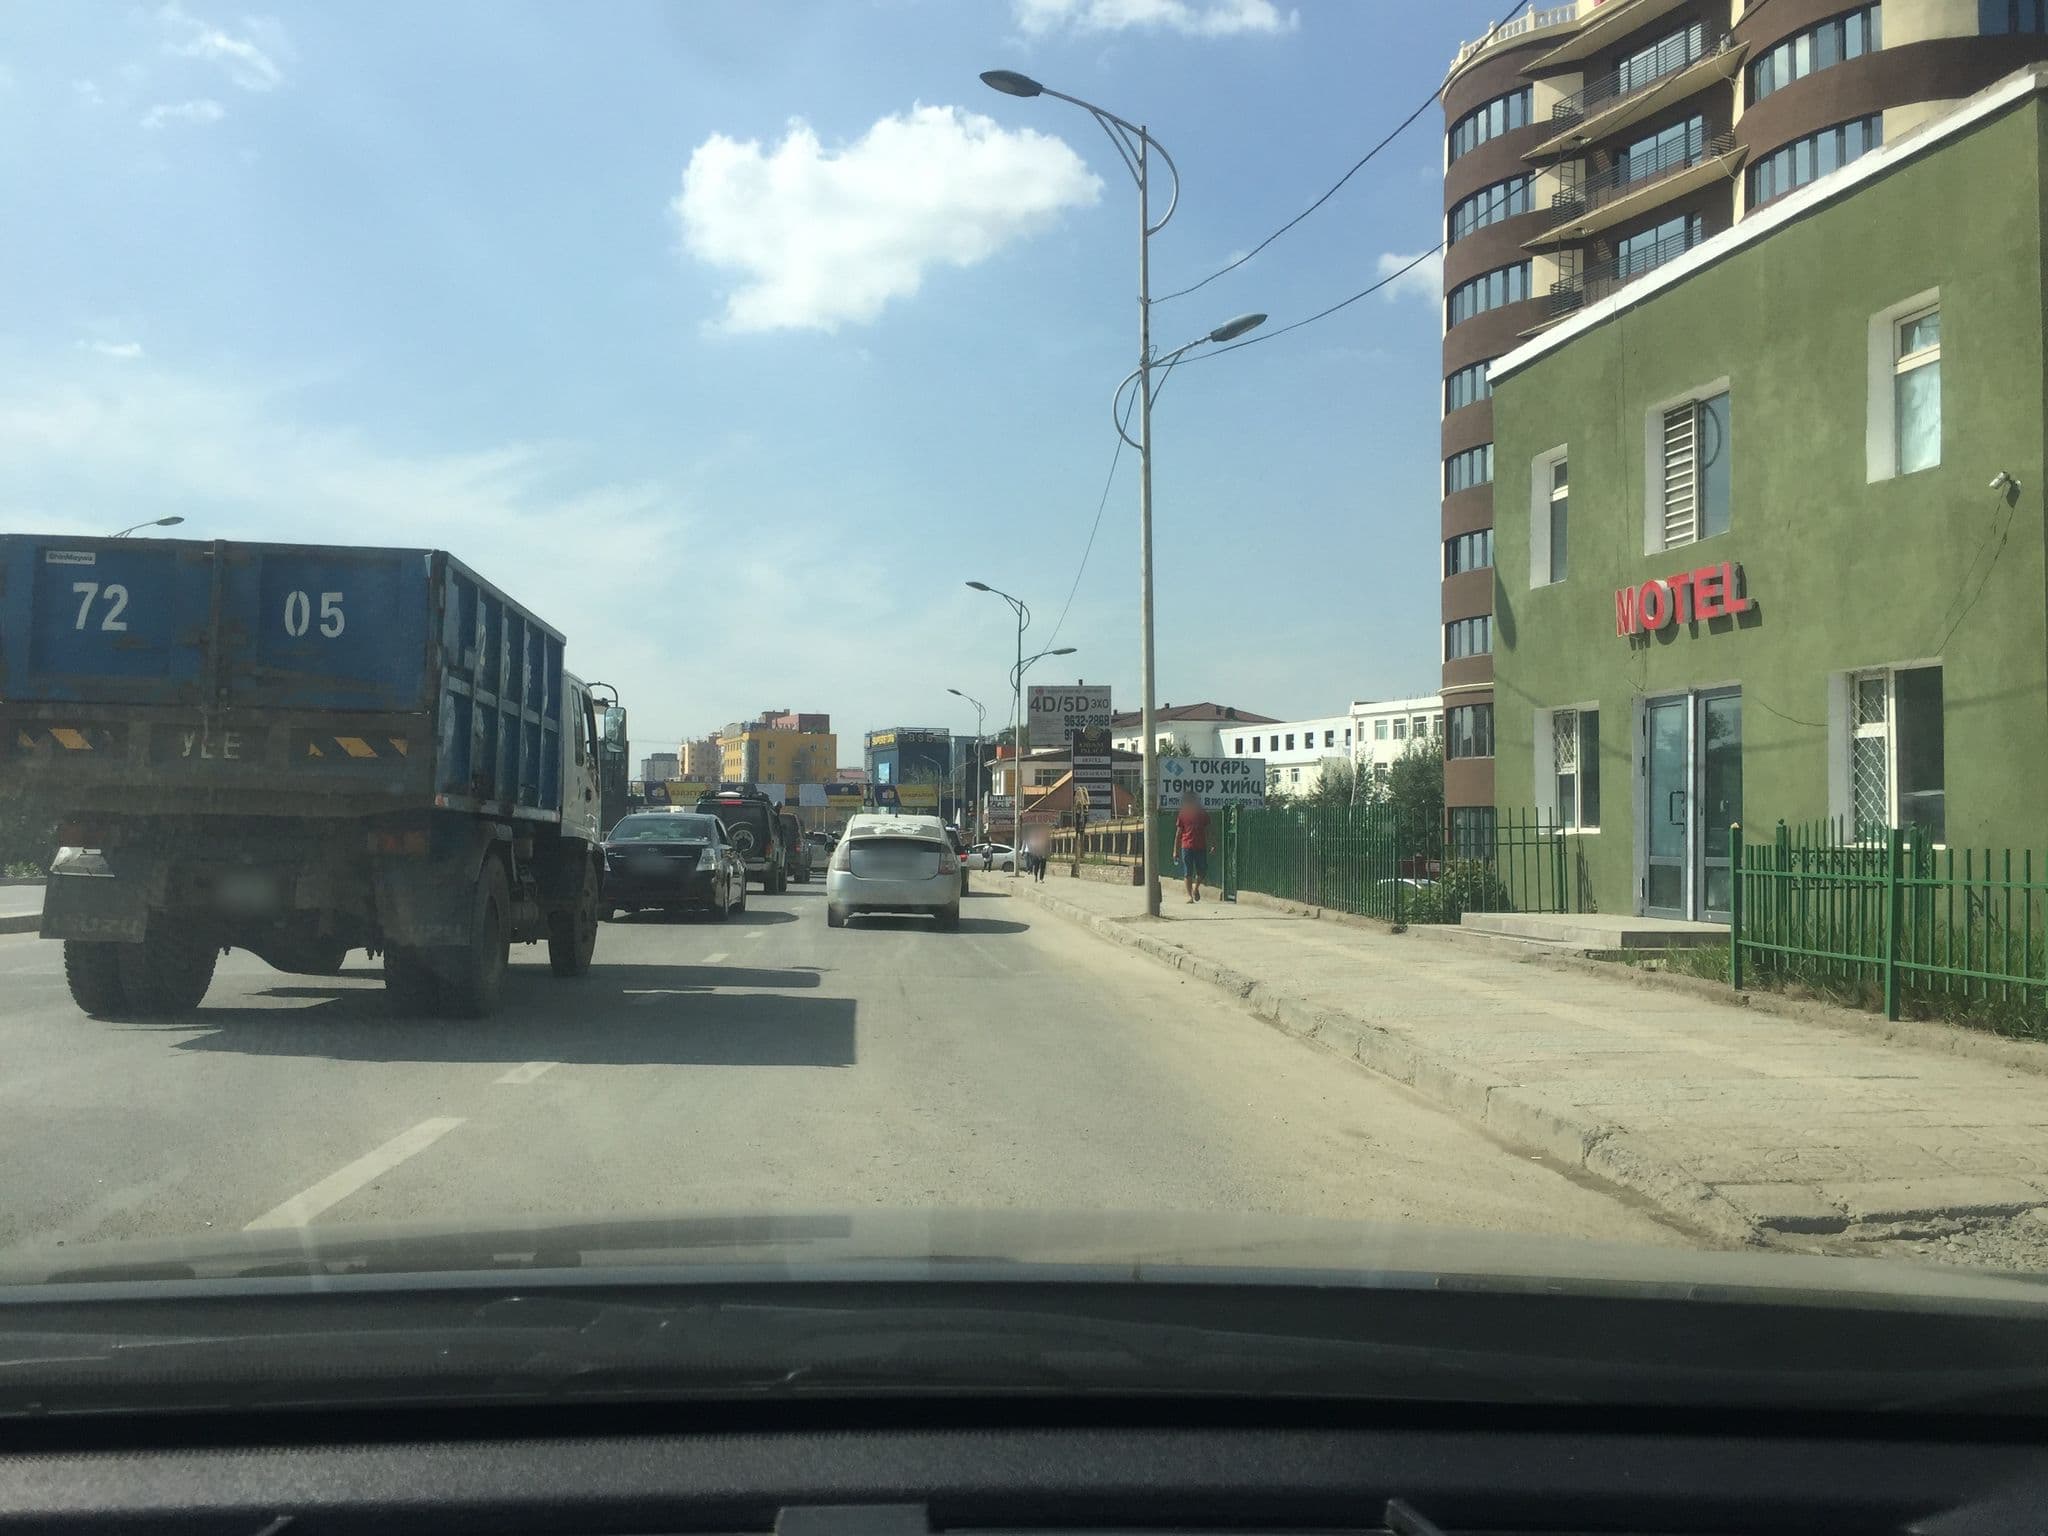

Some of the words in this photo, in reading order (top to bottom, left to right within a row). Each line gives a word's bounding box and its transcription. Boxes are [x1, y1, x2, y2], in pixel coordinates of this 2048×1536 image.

[72, 582, 129, 631] 72
[284, 590, 345, 638] 05
[1615, 561, 1749, 637] MOTEL
[1030, 695, 1089, 712] 4D/5D
[1190, 759, 1251, 775] ТОКАРЬ
[1162, 779, 1215, 793] ТӨМӨР
[1220, 776, 1263, 797] ХИЙЦ
